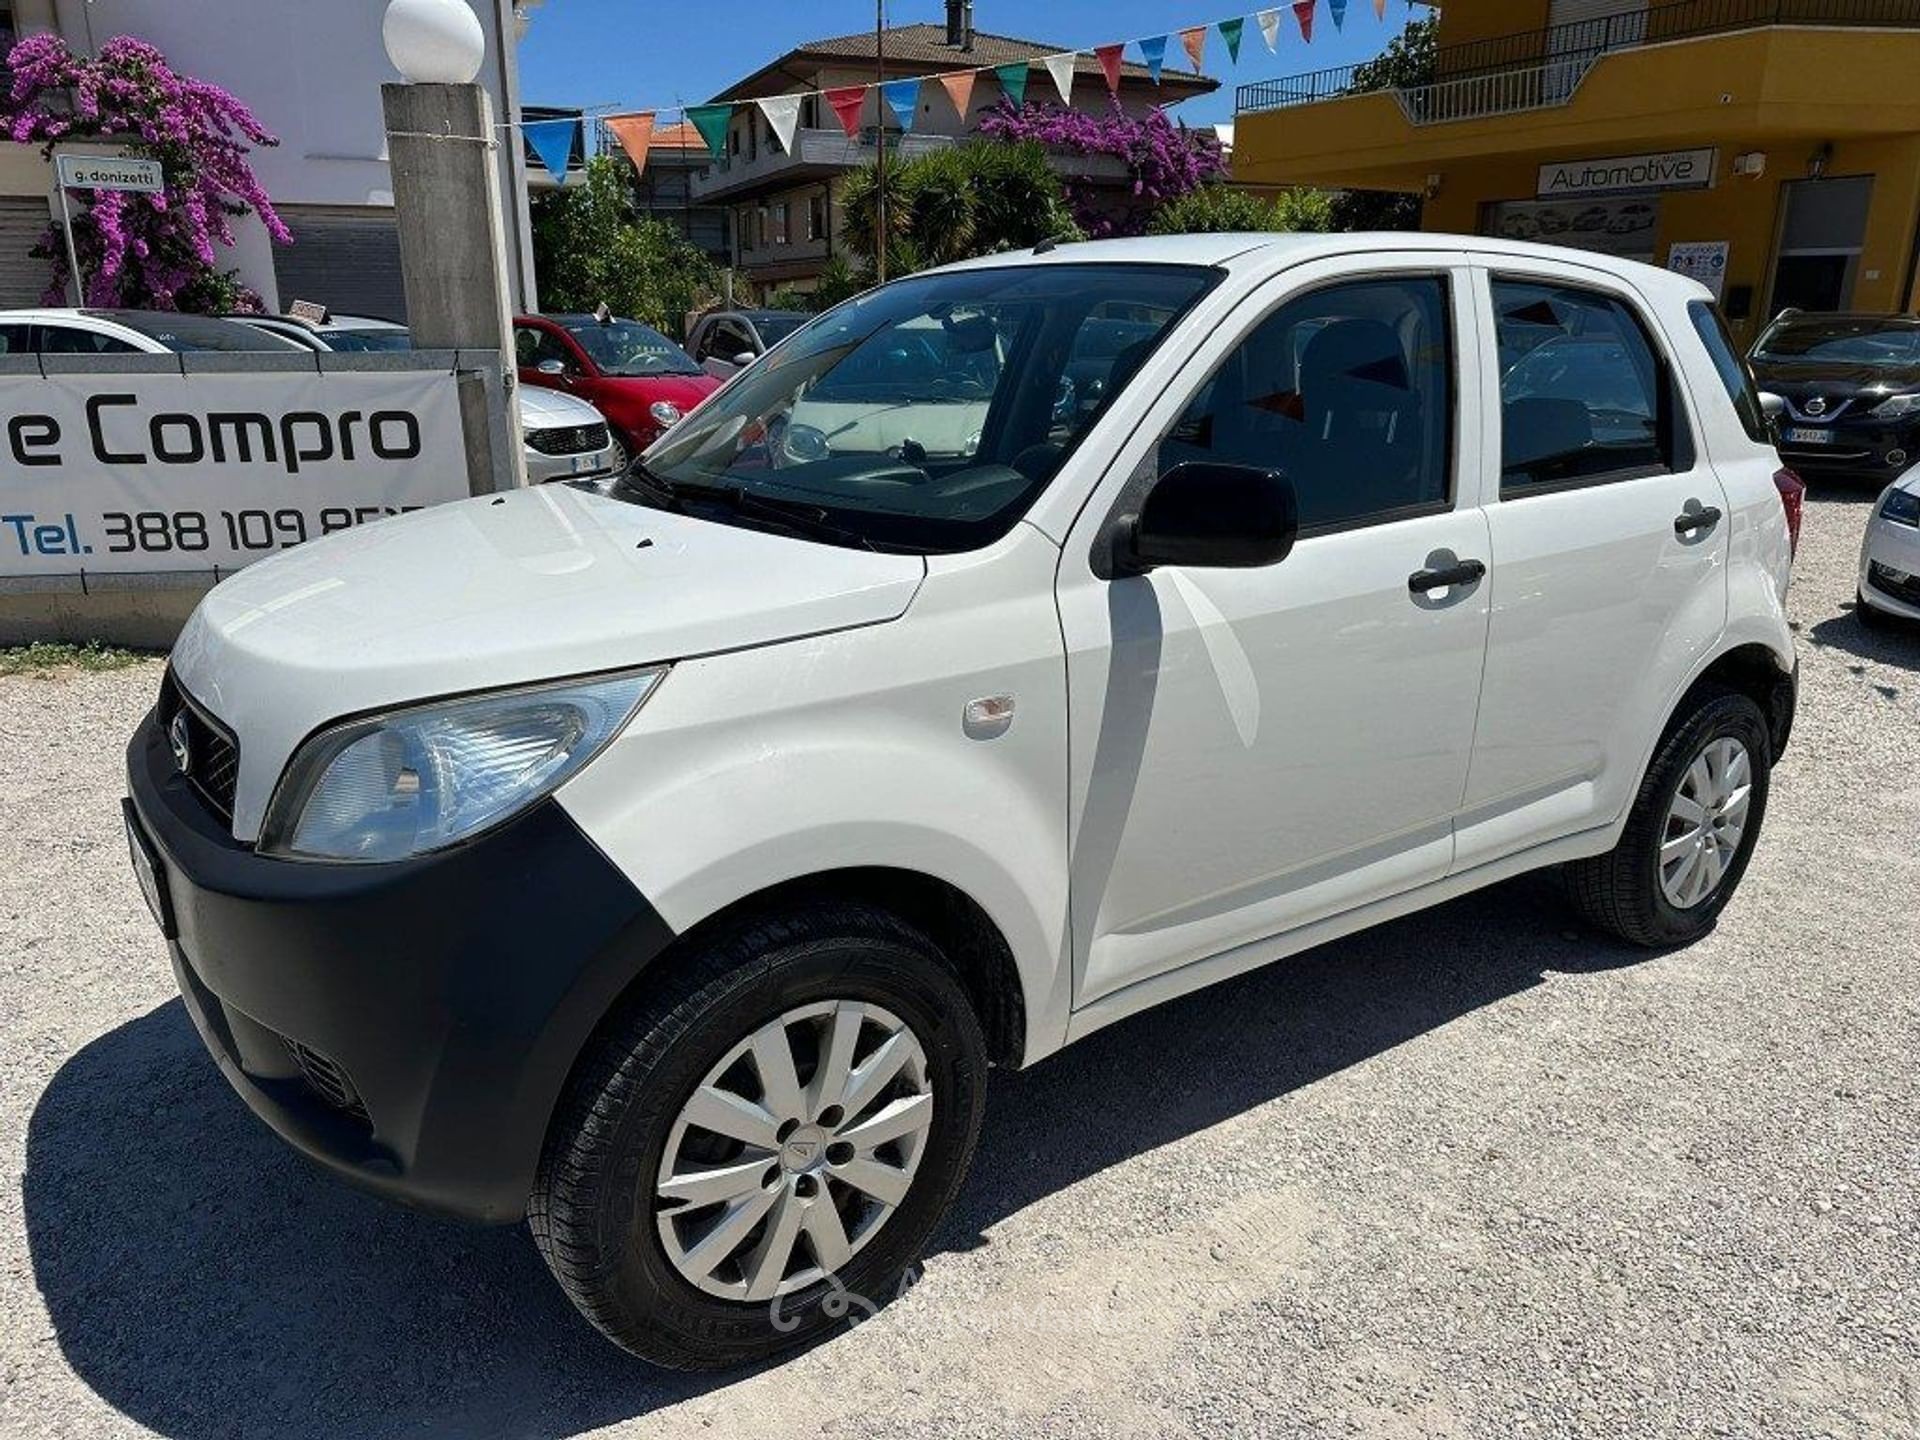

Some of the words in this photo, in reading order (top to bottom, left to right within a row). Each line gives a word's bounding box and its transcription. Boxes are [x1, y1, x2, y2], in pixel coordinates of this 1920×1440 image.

[1550, 158, 1693, 189] Automotive
[8, 414, 62, 466] e
[86, 393, 421, 474] Compro
[2, 514, 93, 556] Tel.
[103, 511, 209, 552] 388
[221, 508, 307, 551] 109
